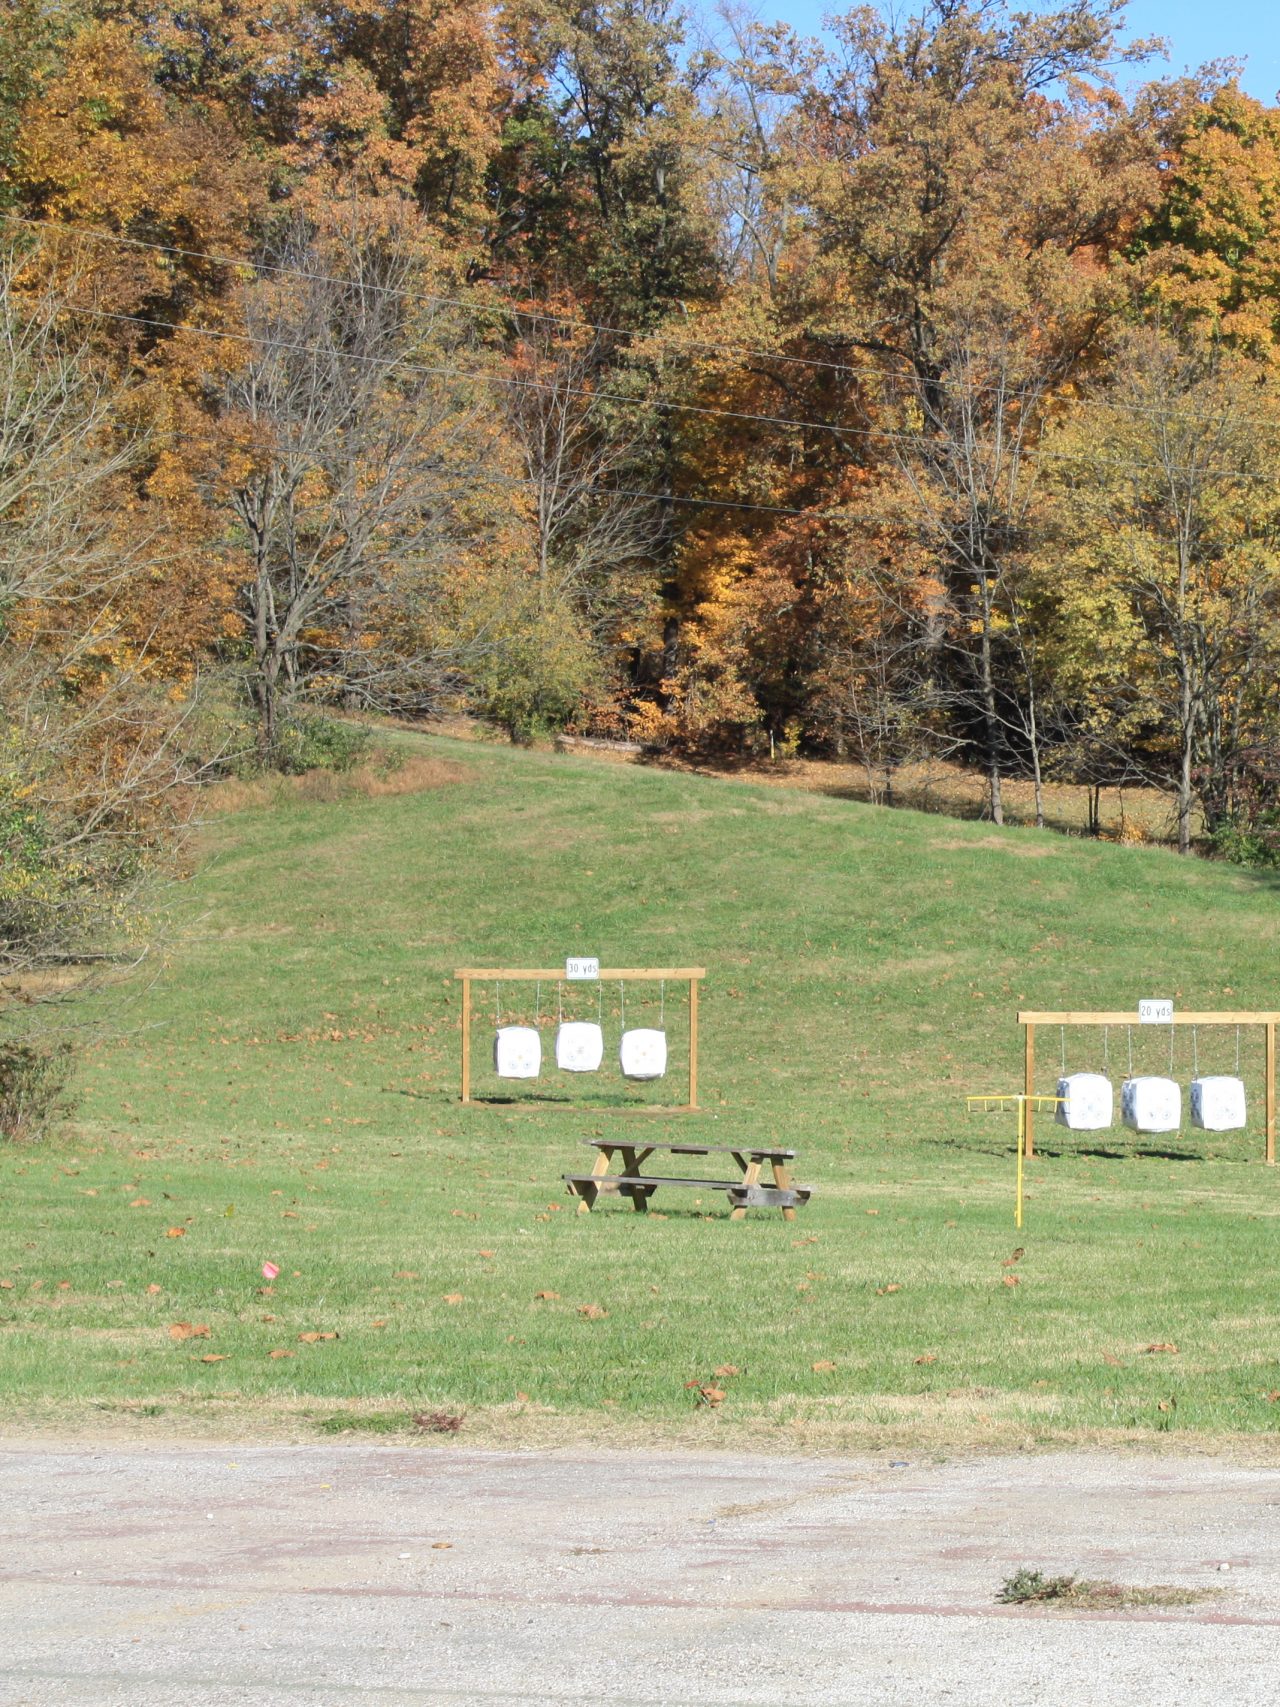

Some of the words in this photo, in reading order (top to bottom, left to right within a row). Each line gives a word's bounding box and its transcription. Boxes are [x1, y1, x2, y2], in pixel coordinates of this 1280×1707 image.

[568, 963, 579, 973] 30
[582, 964, 597, 975] yds
[1141, 1005, 1151, 1016] 20
[1155, 1006, 1170, 1019] yds
